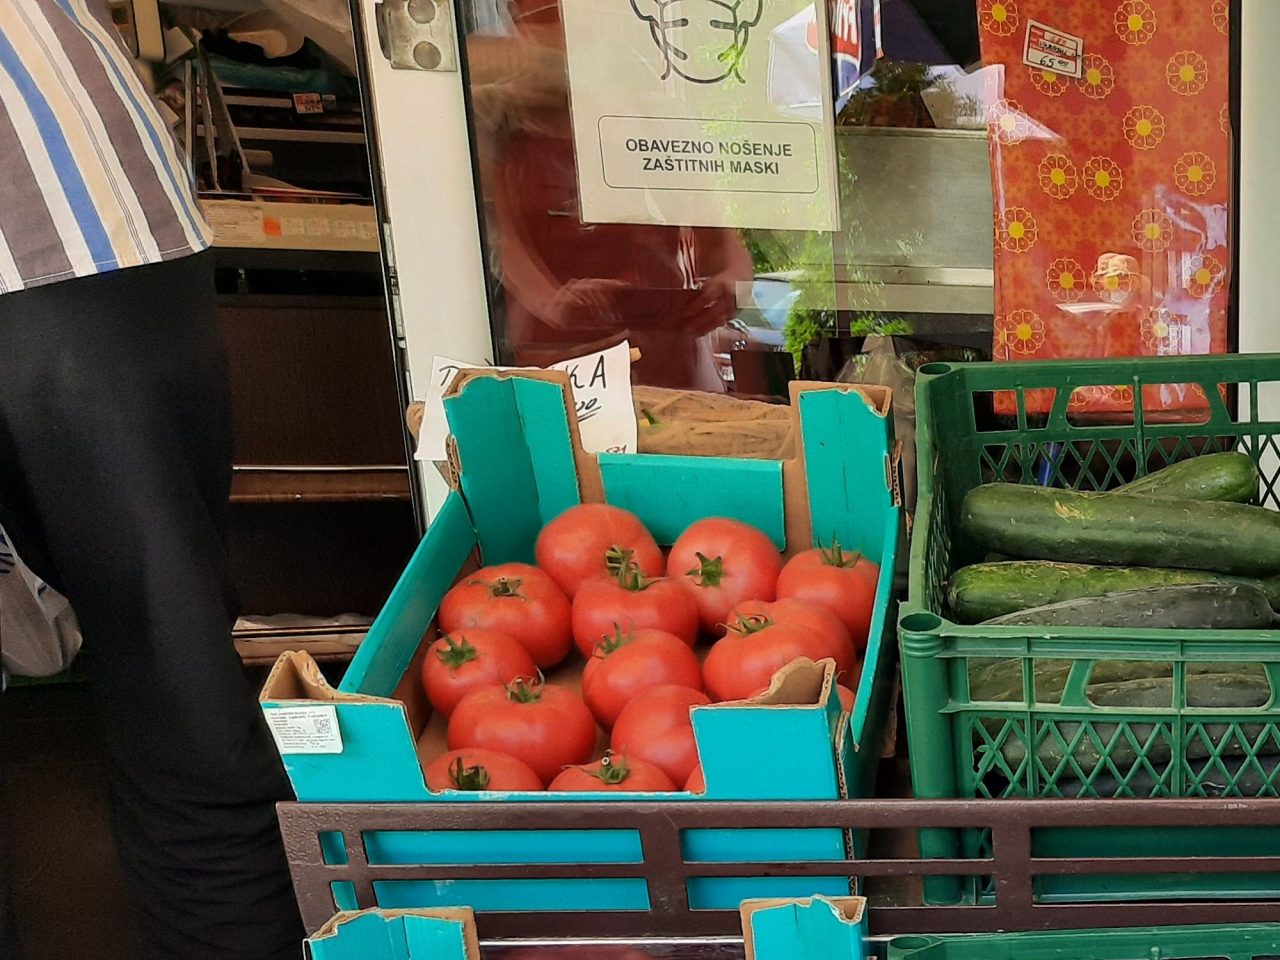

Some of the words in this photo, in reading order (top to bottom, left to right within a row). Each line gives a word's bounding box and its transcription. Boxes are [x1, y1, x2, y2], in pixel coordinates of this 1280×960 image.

[625, 138, 714, 154] OBAVEZNO
[719, 140, 793, 157] NOŠENJE
[643, 155, 725, 173] ZAŠTITNIH
[730, 160, 780, 175] MASKI
